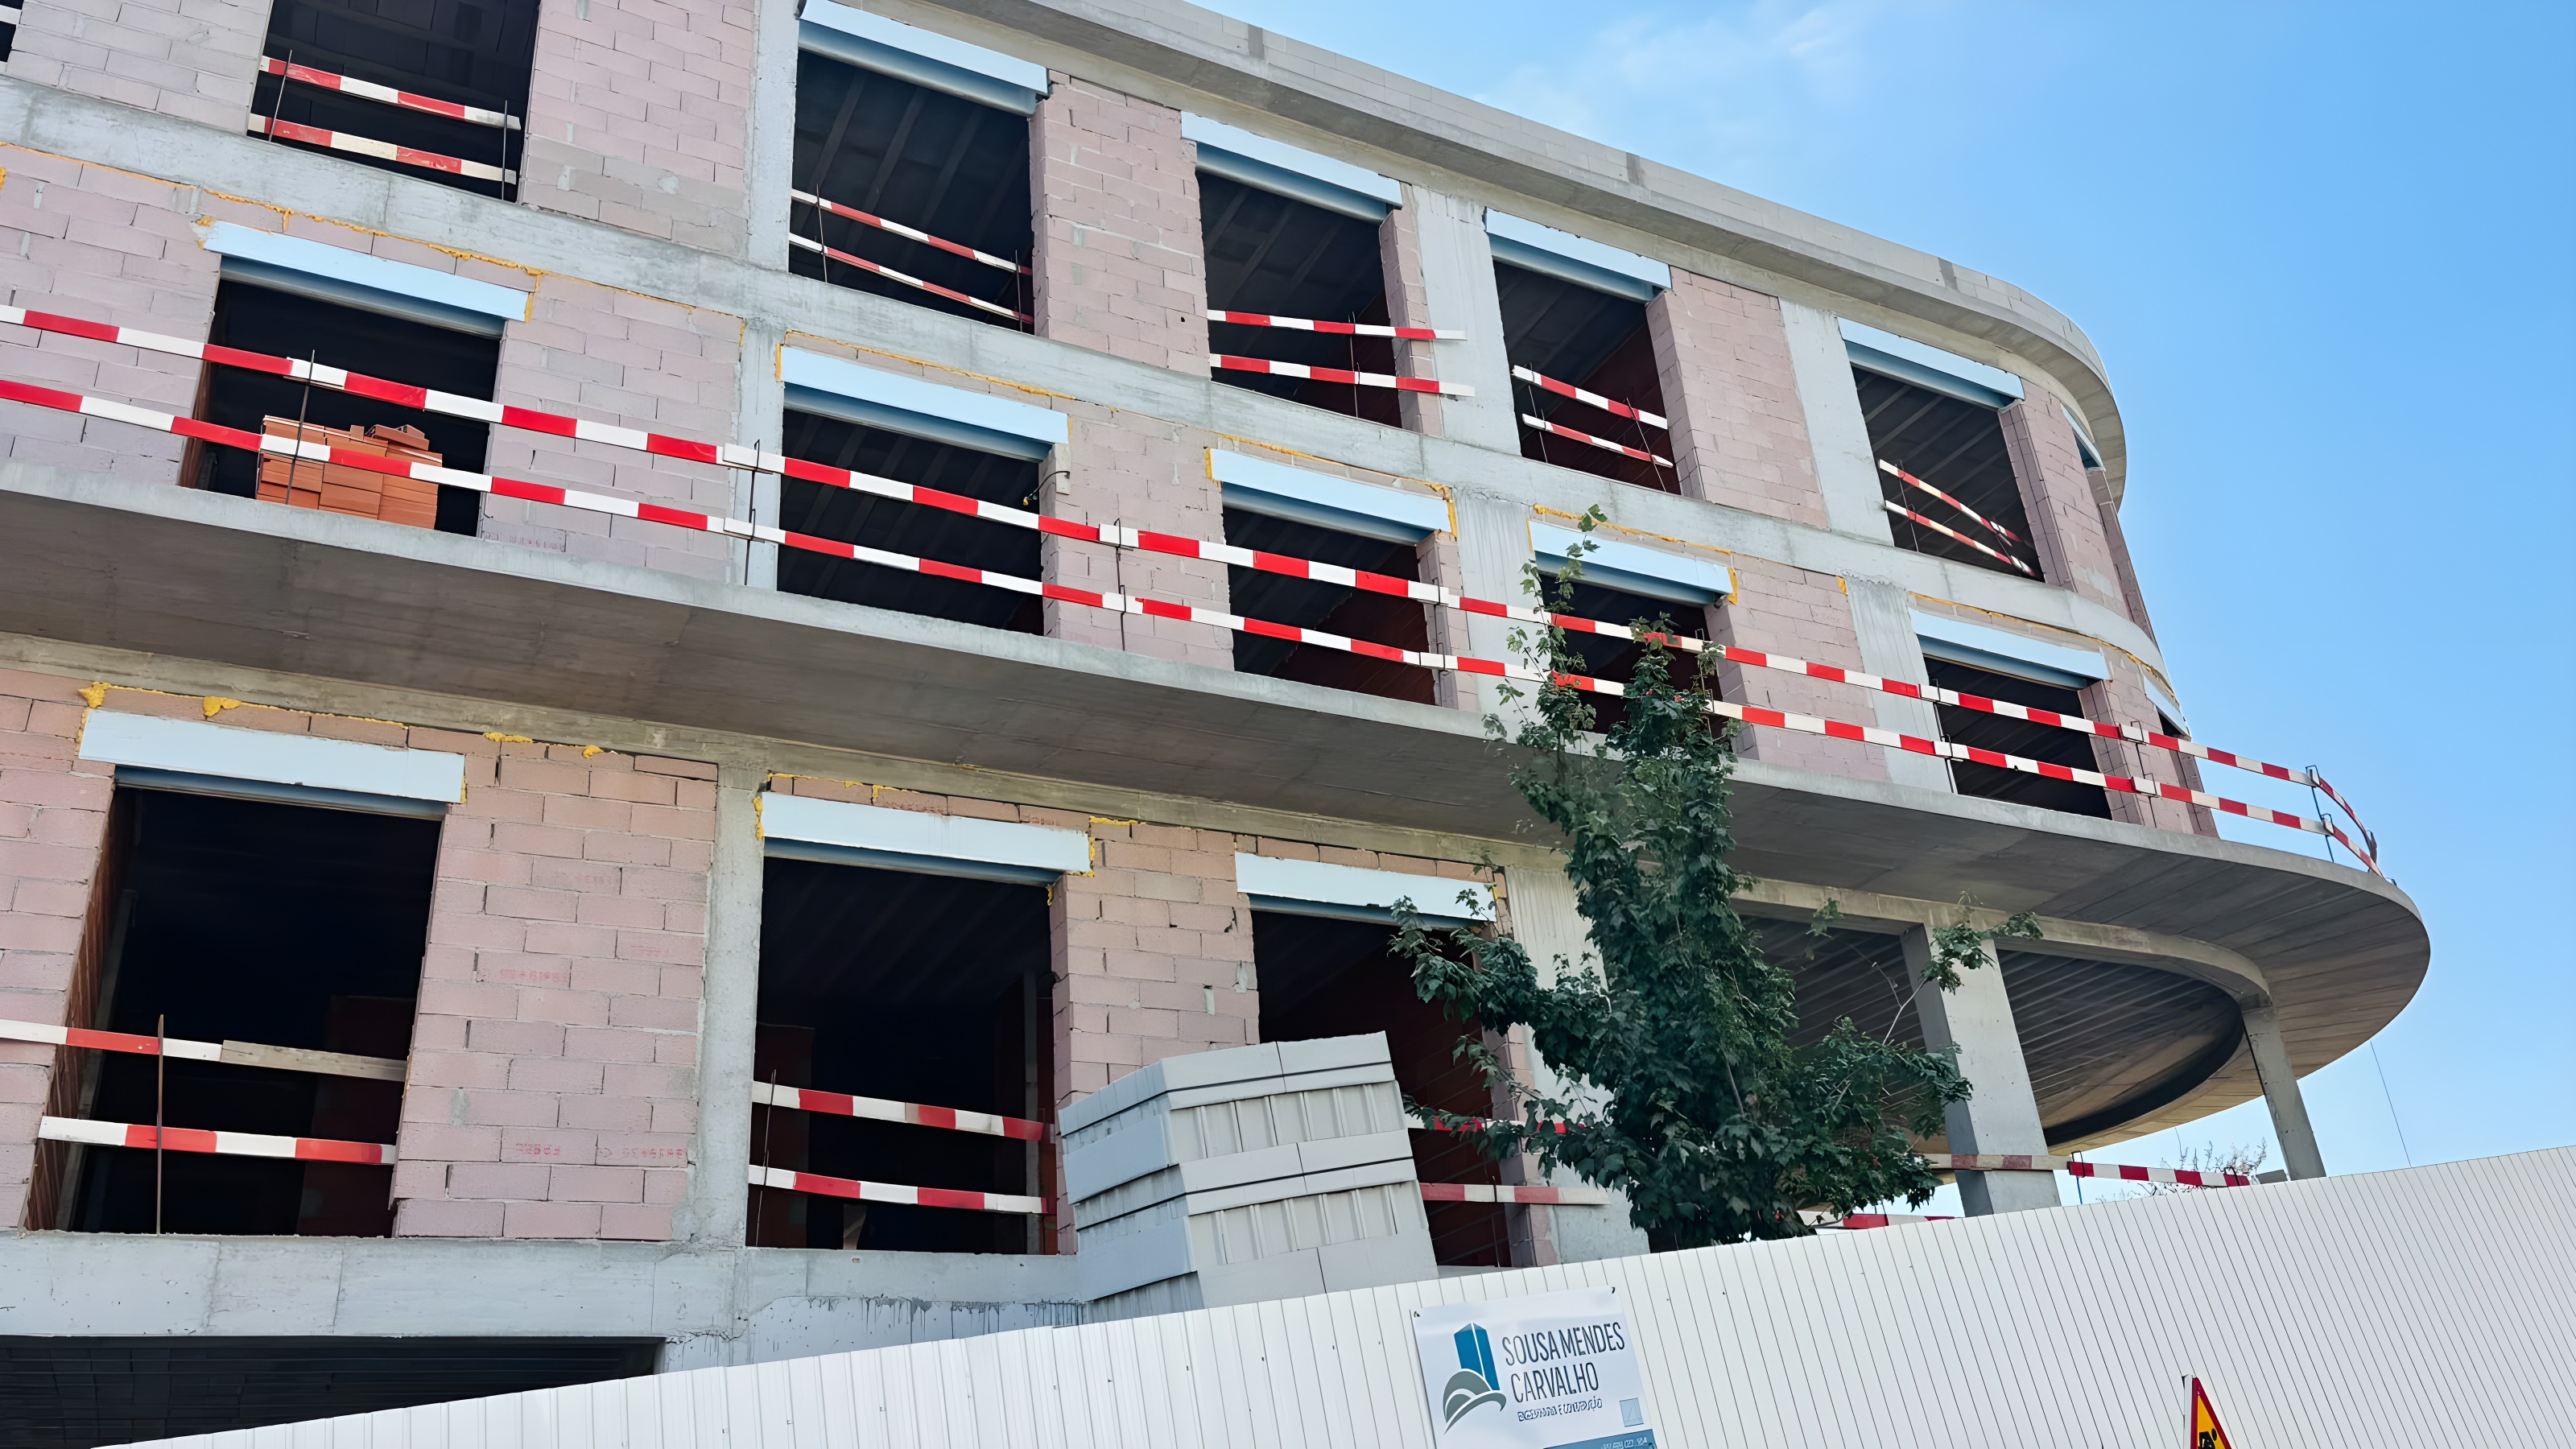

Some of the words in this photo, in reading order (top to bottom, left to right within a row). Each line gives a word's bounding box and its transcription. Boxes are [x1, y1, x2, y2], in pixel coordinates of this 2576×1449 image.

[1501, 1329, 1561, 1366] SOUSA
[1559, 1322, 1625, 1357] MENDES
[1510, 1362, 1599, 1403] CARVALHO
